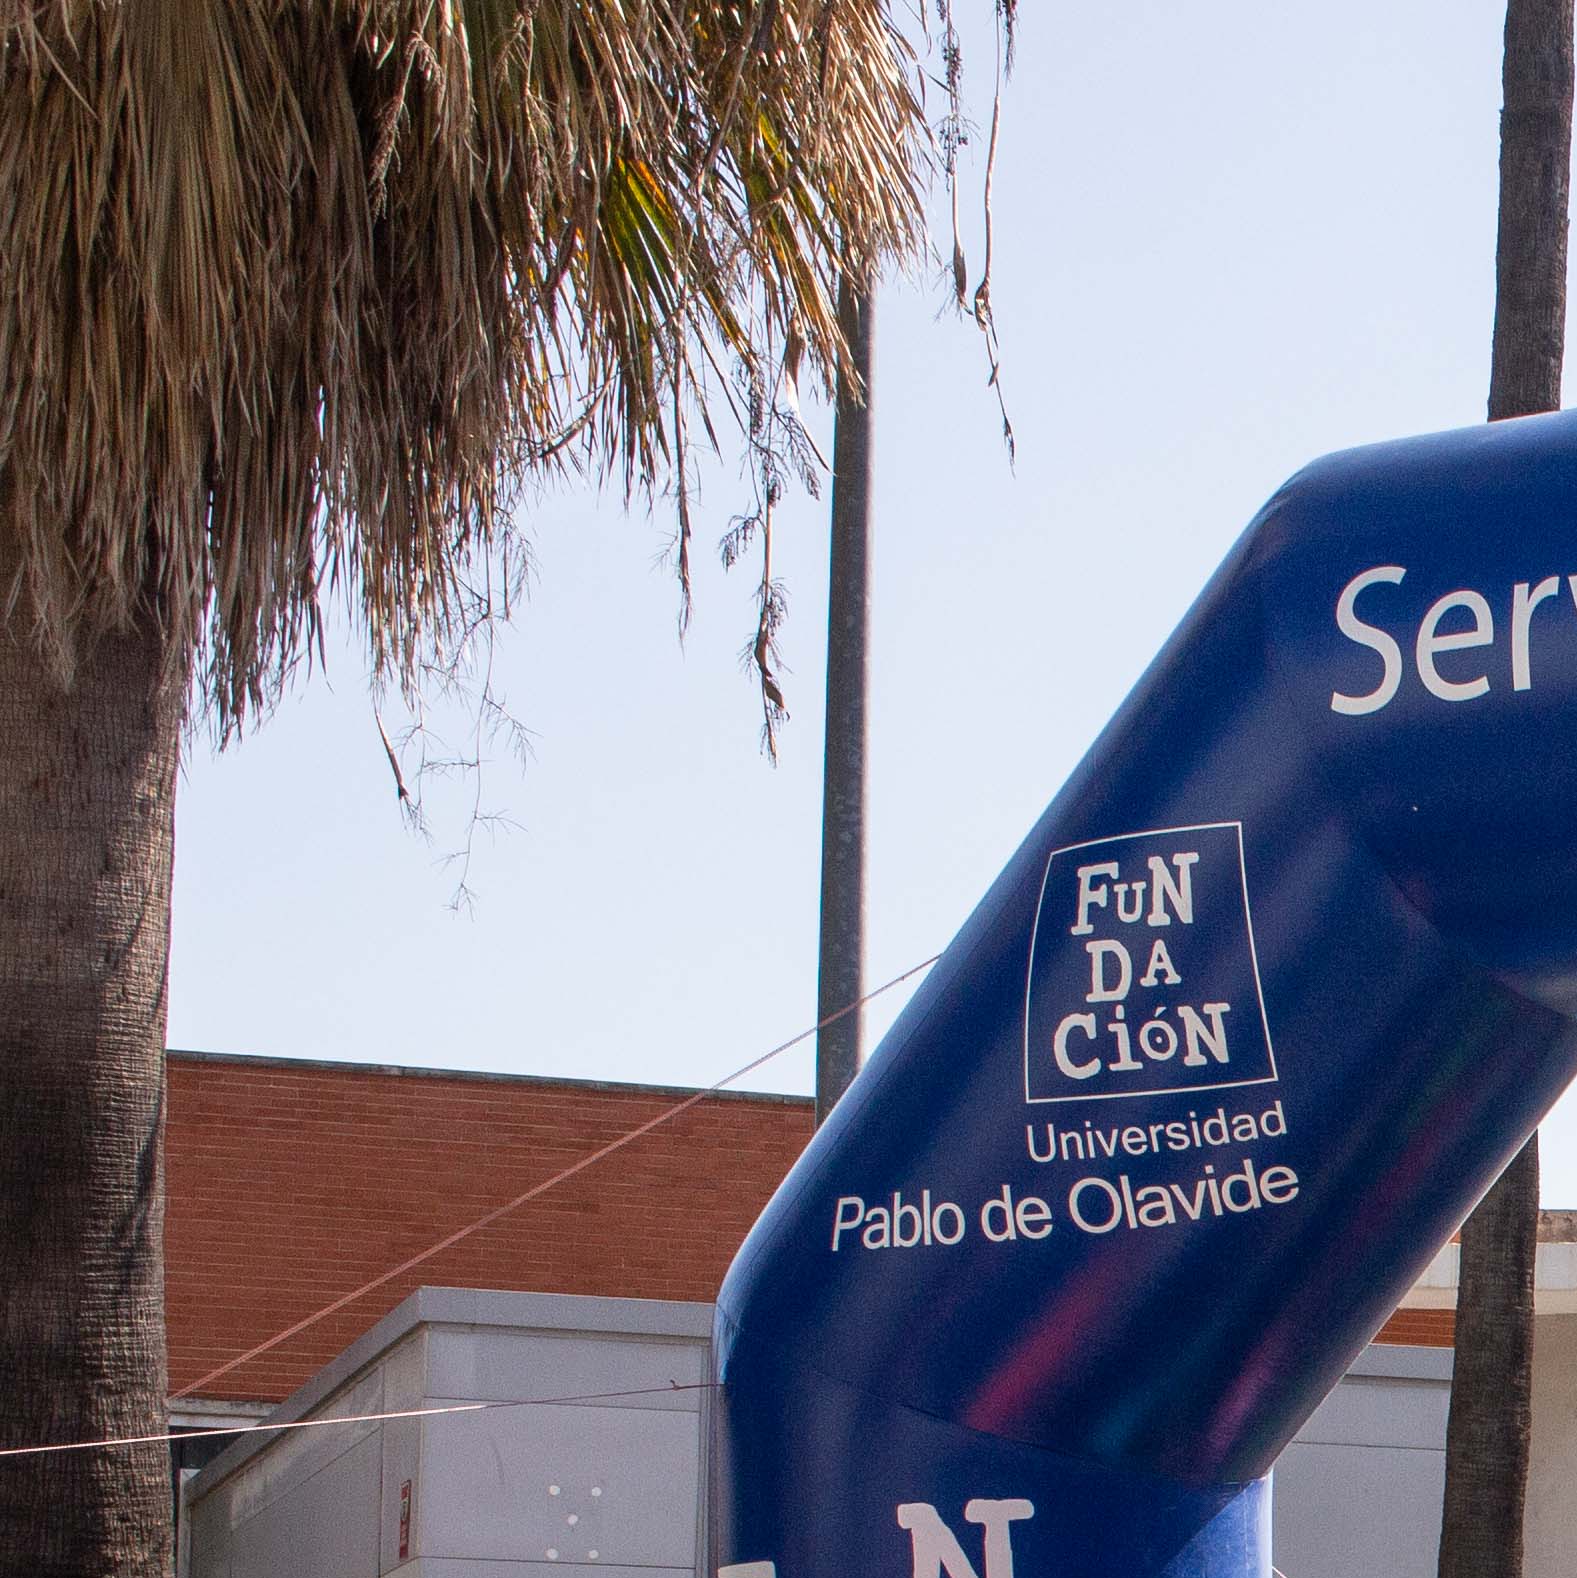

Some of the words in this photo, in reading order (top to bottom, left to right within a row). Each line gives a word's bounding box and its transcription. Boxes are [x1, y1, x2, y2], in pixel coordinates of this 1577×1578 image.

[1086, 939, 1182, 1003] DA
[1026, 1101, 1289, 1163] Universidad
[831, 1190, 965, 1252] Pablo
[981, 1184, 1053, 1243] de
[1068, 1157, 1300, 1235] Olavide
